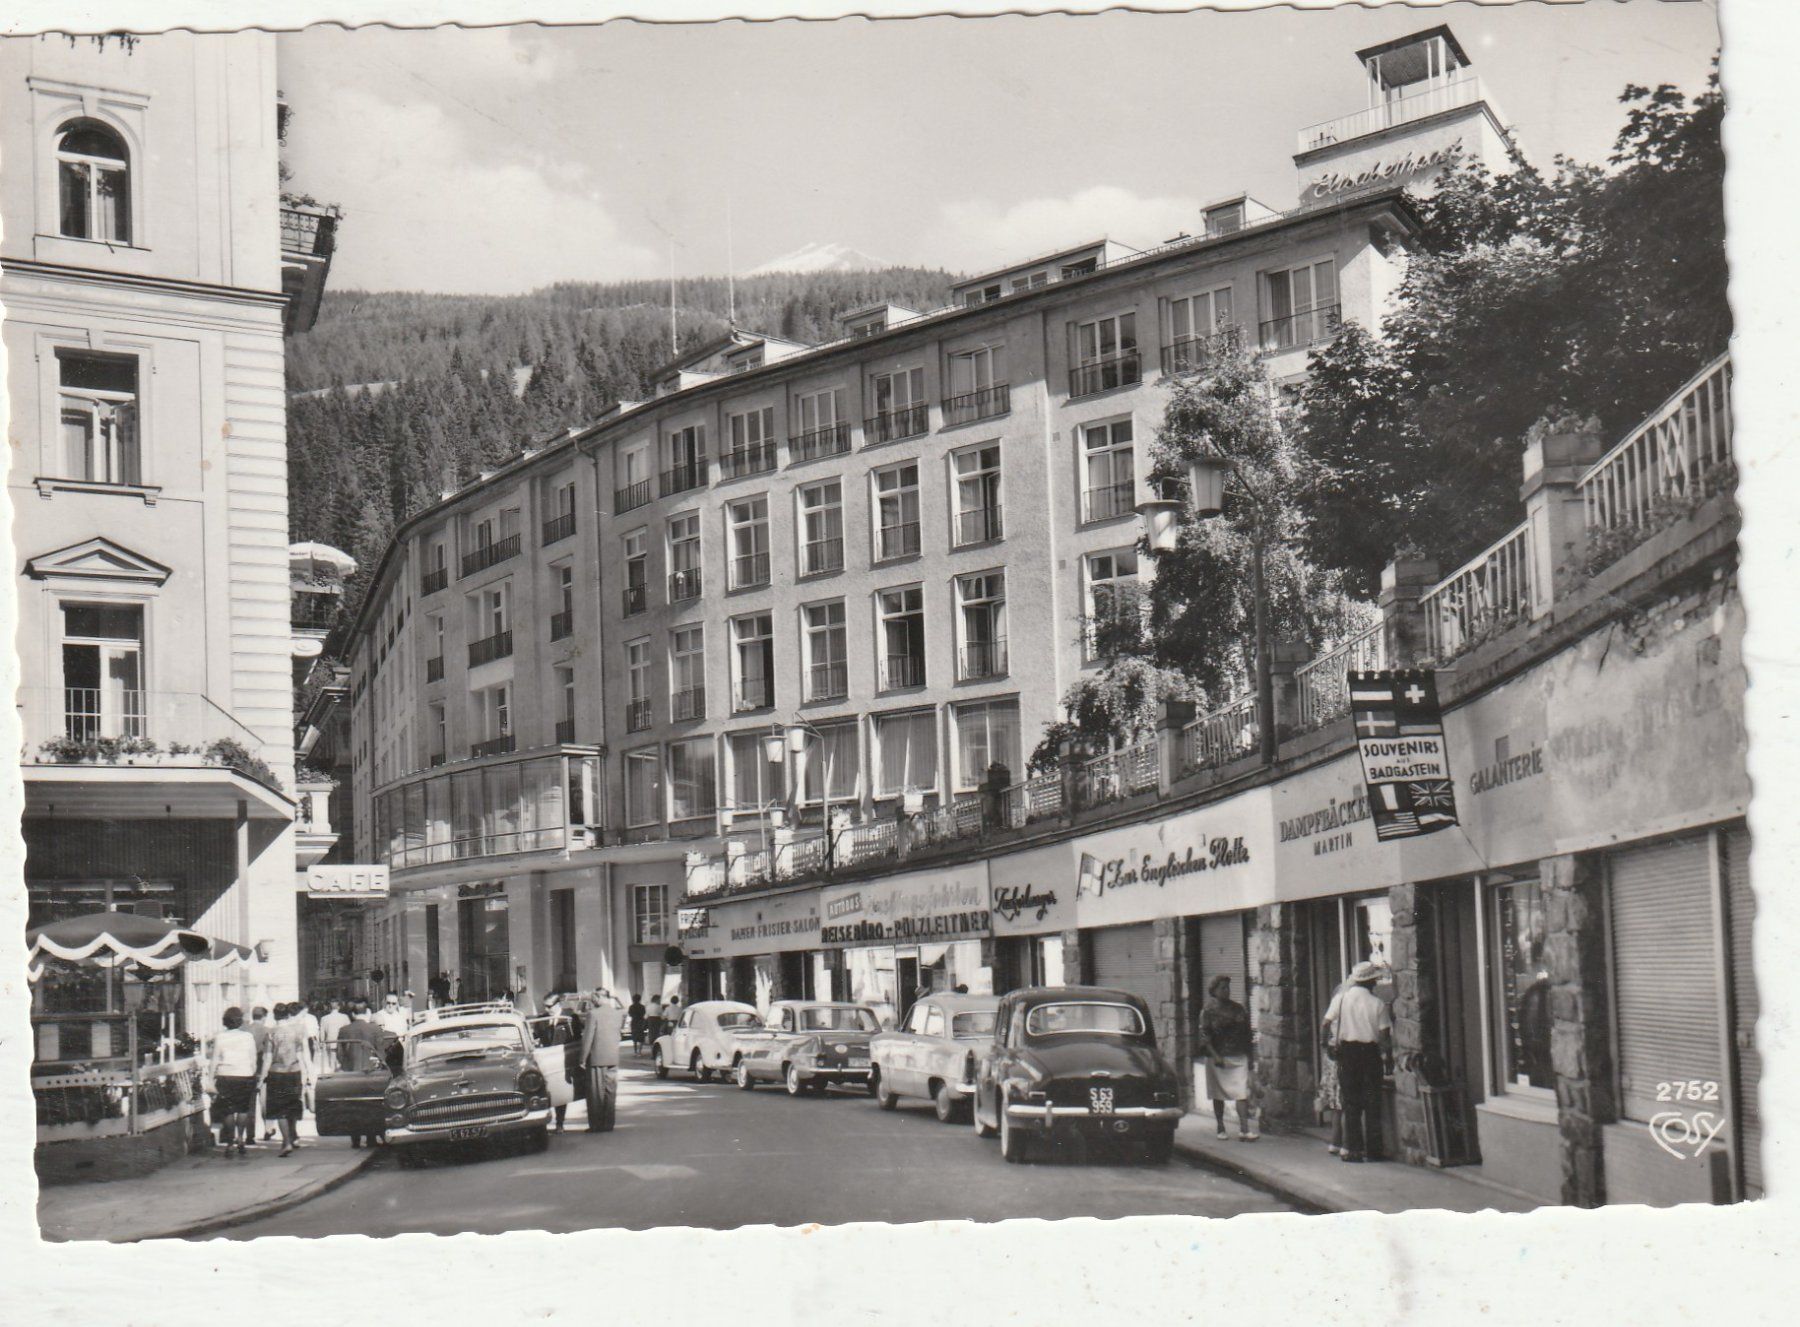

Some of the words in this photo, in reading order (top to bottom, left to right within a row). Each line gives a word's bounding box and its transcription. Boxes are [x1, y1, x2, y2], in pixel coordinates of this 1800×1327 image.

[1363, 740, 1439, 758] SOUVENIRS
[1370, 763, 1440, 779] BADGASTEIN
[1470, 746, 1544, 796] GALANTERIE
[1313, 832, 1352, 856] MARTIN
[1107, 859, 1138, 889] Zur
[1141, 846, 1207, 887] Englischen
